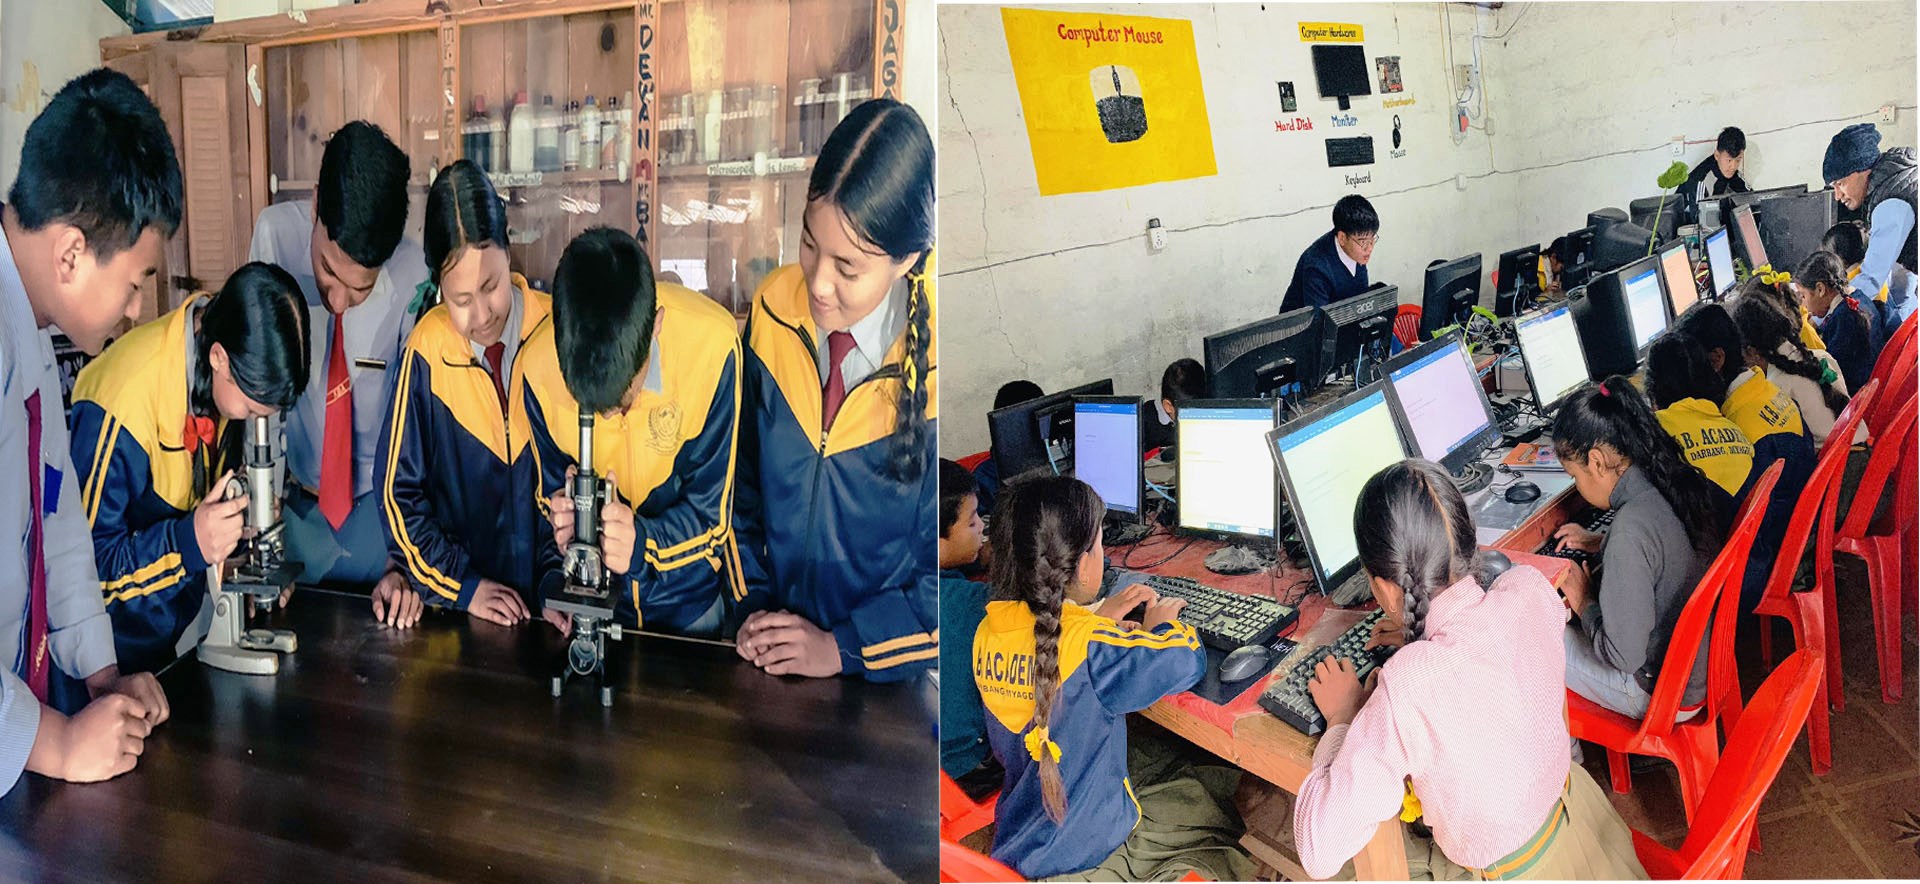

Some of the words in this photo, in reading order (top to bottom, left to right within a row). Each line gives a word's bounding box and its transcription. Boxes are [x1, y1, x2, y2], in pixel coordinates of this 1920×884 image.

[1057, 20, 1120, 47] Computer
[1124, 26, 1164, 44] Mouse
[1301, 25, 1328, 40] Computer
[1274, 119, 1295, 132] Hard
[1296, 117, 1314, 130] Disk
[1345, 170, 1372, 189] Keyboard
[1356, 301, 1375, 314] acer
